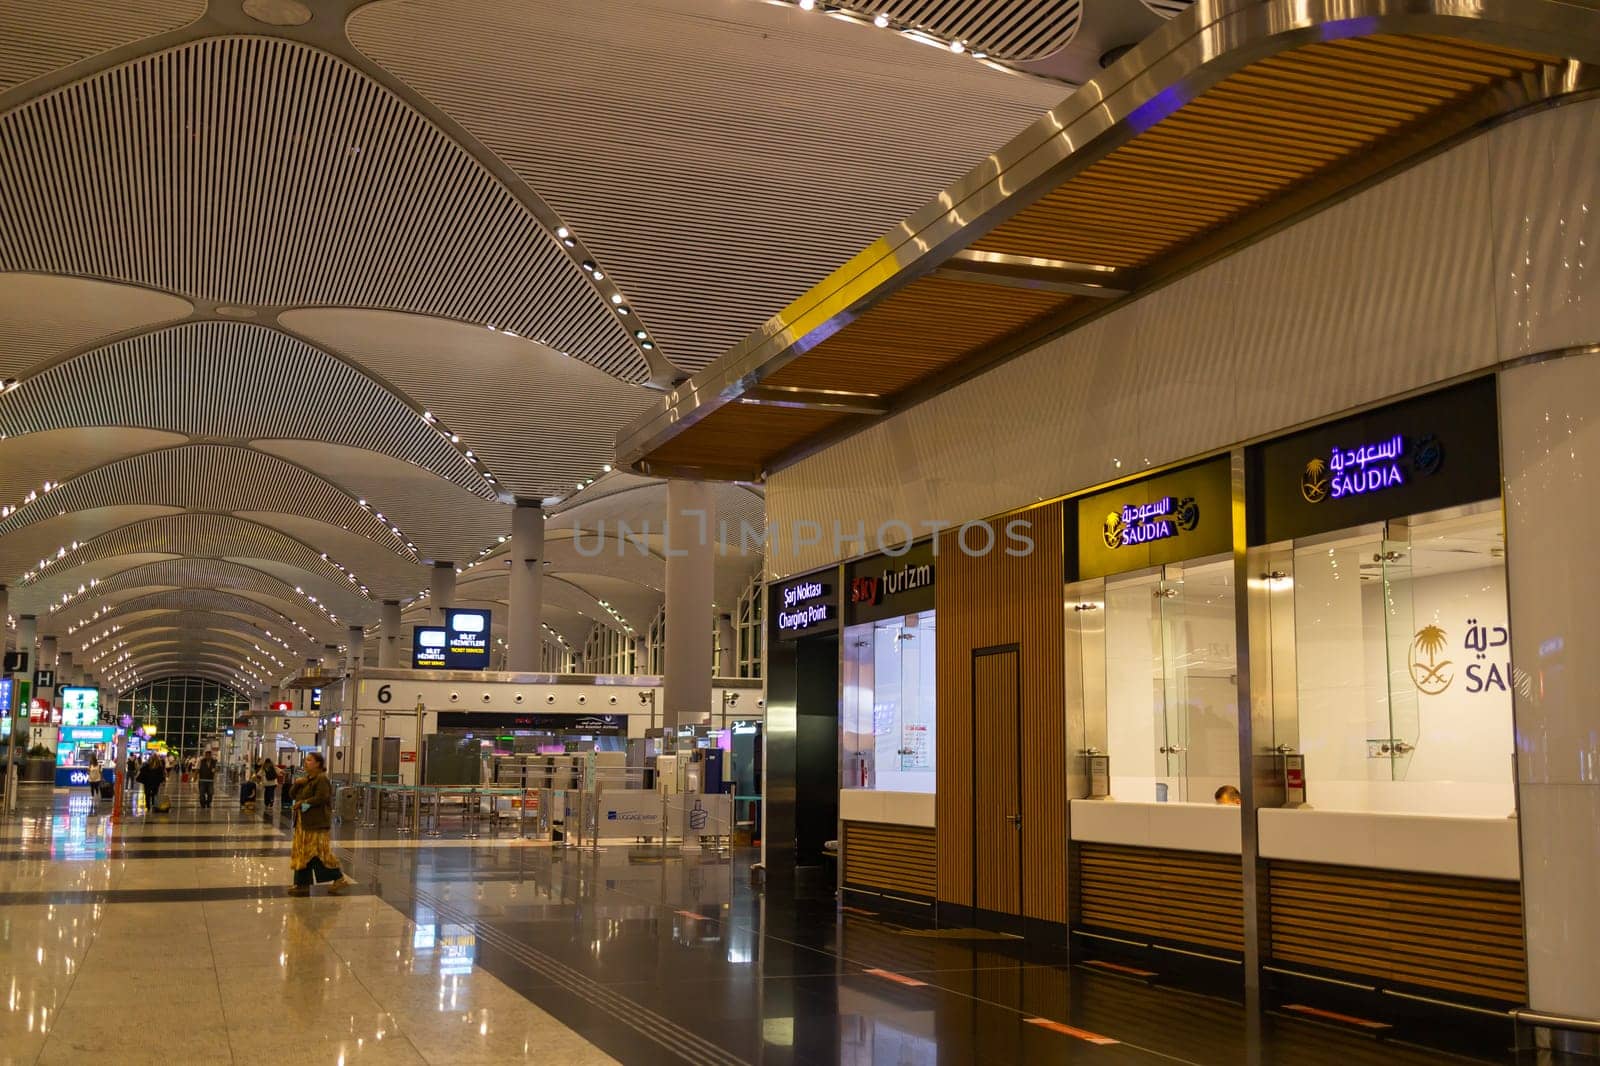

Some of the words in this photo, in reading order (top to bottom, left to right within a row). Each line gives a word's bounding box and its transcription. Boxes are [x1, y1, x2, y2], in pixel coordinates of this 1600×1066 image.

[1330, 436, 1401, 475] السعودية
[1331, 464, 1402, 497] SAUDIA
[1122, 497, 1169, 528] السعودية
[1122, 521, 1170, 546] SAUDIA
[784, 588, 797, 608] Şarj
[796, 582, 822, 601] Noktası
[851, 577, 877, 607] sky
[882, 563, 931, 595] turizm
[779, 609, 808, 630] Charging
[808, 604, 827, 623] Point
[12, 654, 21, 670] J
[38, 672, 50, 686] H
[377, 684, 392, 703] 6
[283, 719, 291, 730] 5
[71, 772, 89, 784] döv
